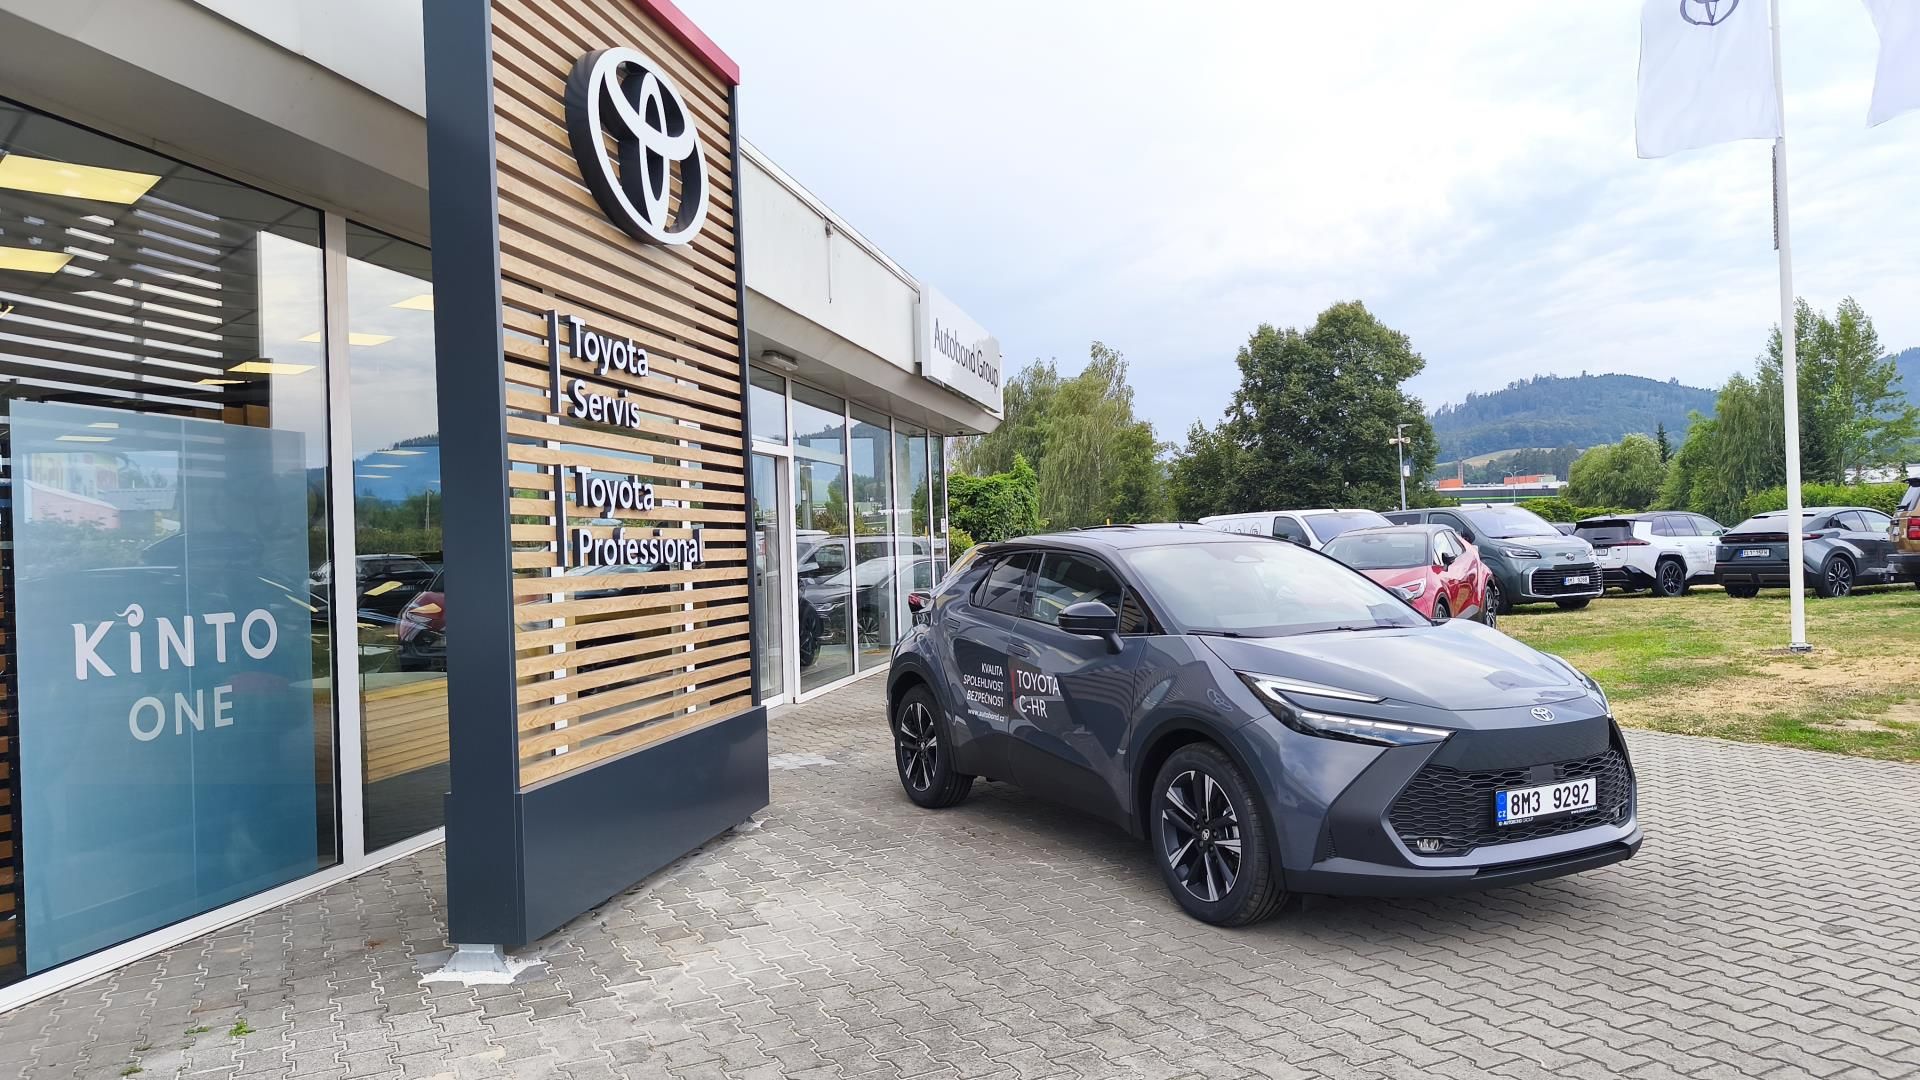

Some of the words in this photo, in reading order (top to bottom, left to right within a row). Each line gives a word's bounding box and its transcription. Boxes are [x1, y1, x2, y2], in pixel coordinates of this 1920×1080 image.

[569, 315, 648, 377] Toyota
[935, 317, 975, 373] Autobond
[977, 349, 998, 394] Group
[571, 379, 640, 429] Servis
[576, 465, 655, 518] Toyota
[579, 527, 704, 567] Professional
[964, 674, 1004, 692] SPOLEHLIVOST
[982, 662, 1003, 677] KVALITA
[1017, 670, 1060, 696] TOYOTA
[128, 684, 234, 742] ONE
[966, 690, 1004, 708] BEZPEČNOST
[1019, 695, 1048, 718] C-HR
[1511, 791, 1540, 816] 8M3
[1553, 783, 1588, 809] 9292
